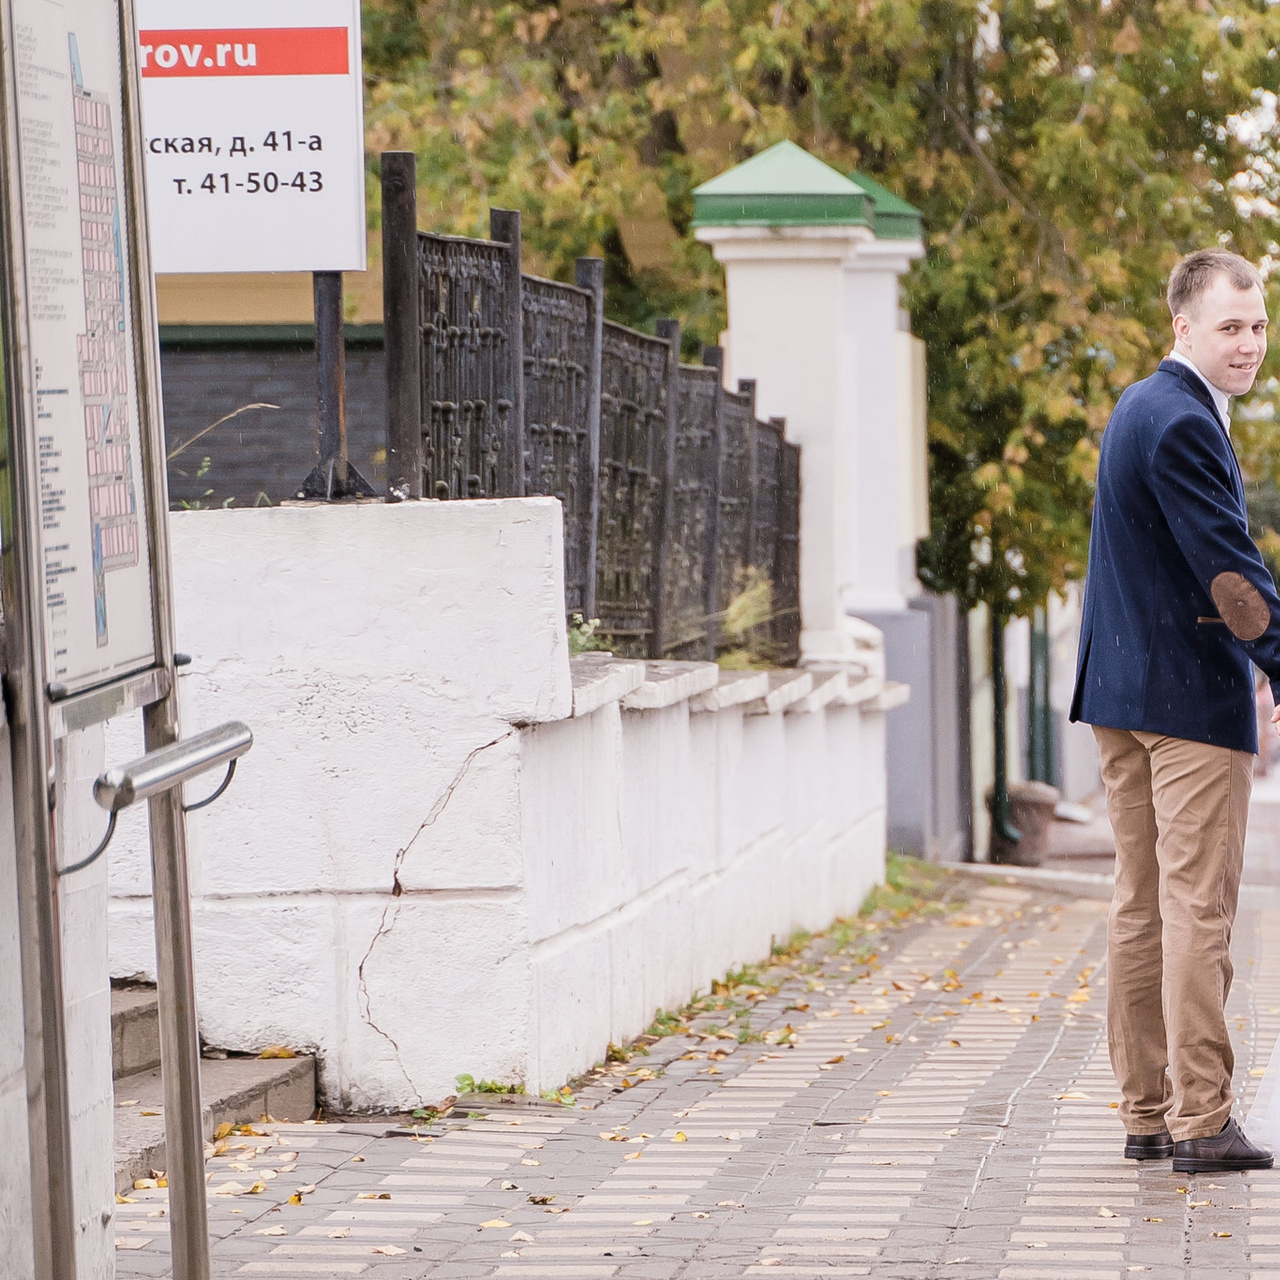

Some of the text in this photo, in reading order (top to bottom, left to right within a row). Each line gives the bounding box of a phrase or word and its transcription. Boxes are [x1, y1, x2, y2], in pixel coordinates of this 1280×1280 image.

[140, 42, 257, 69] rov.ru
[145, 130, 323, 157] ская, д. 41-а
[173, 170, 324, 195] т. 41-50-43
